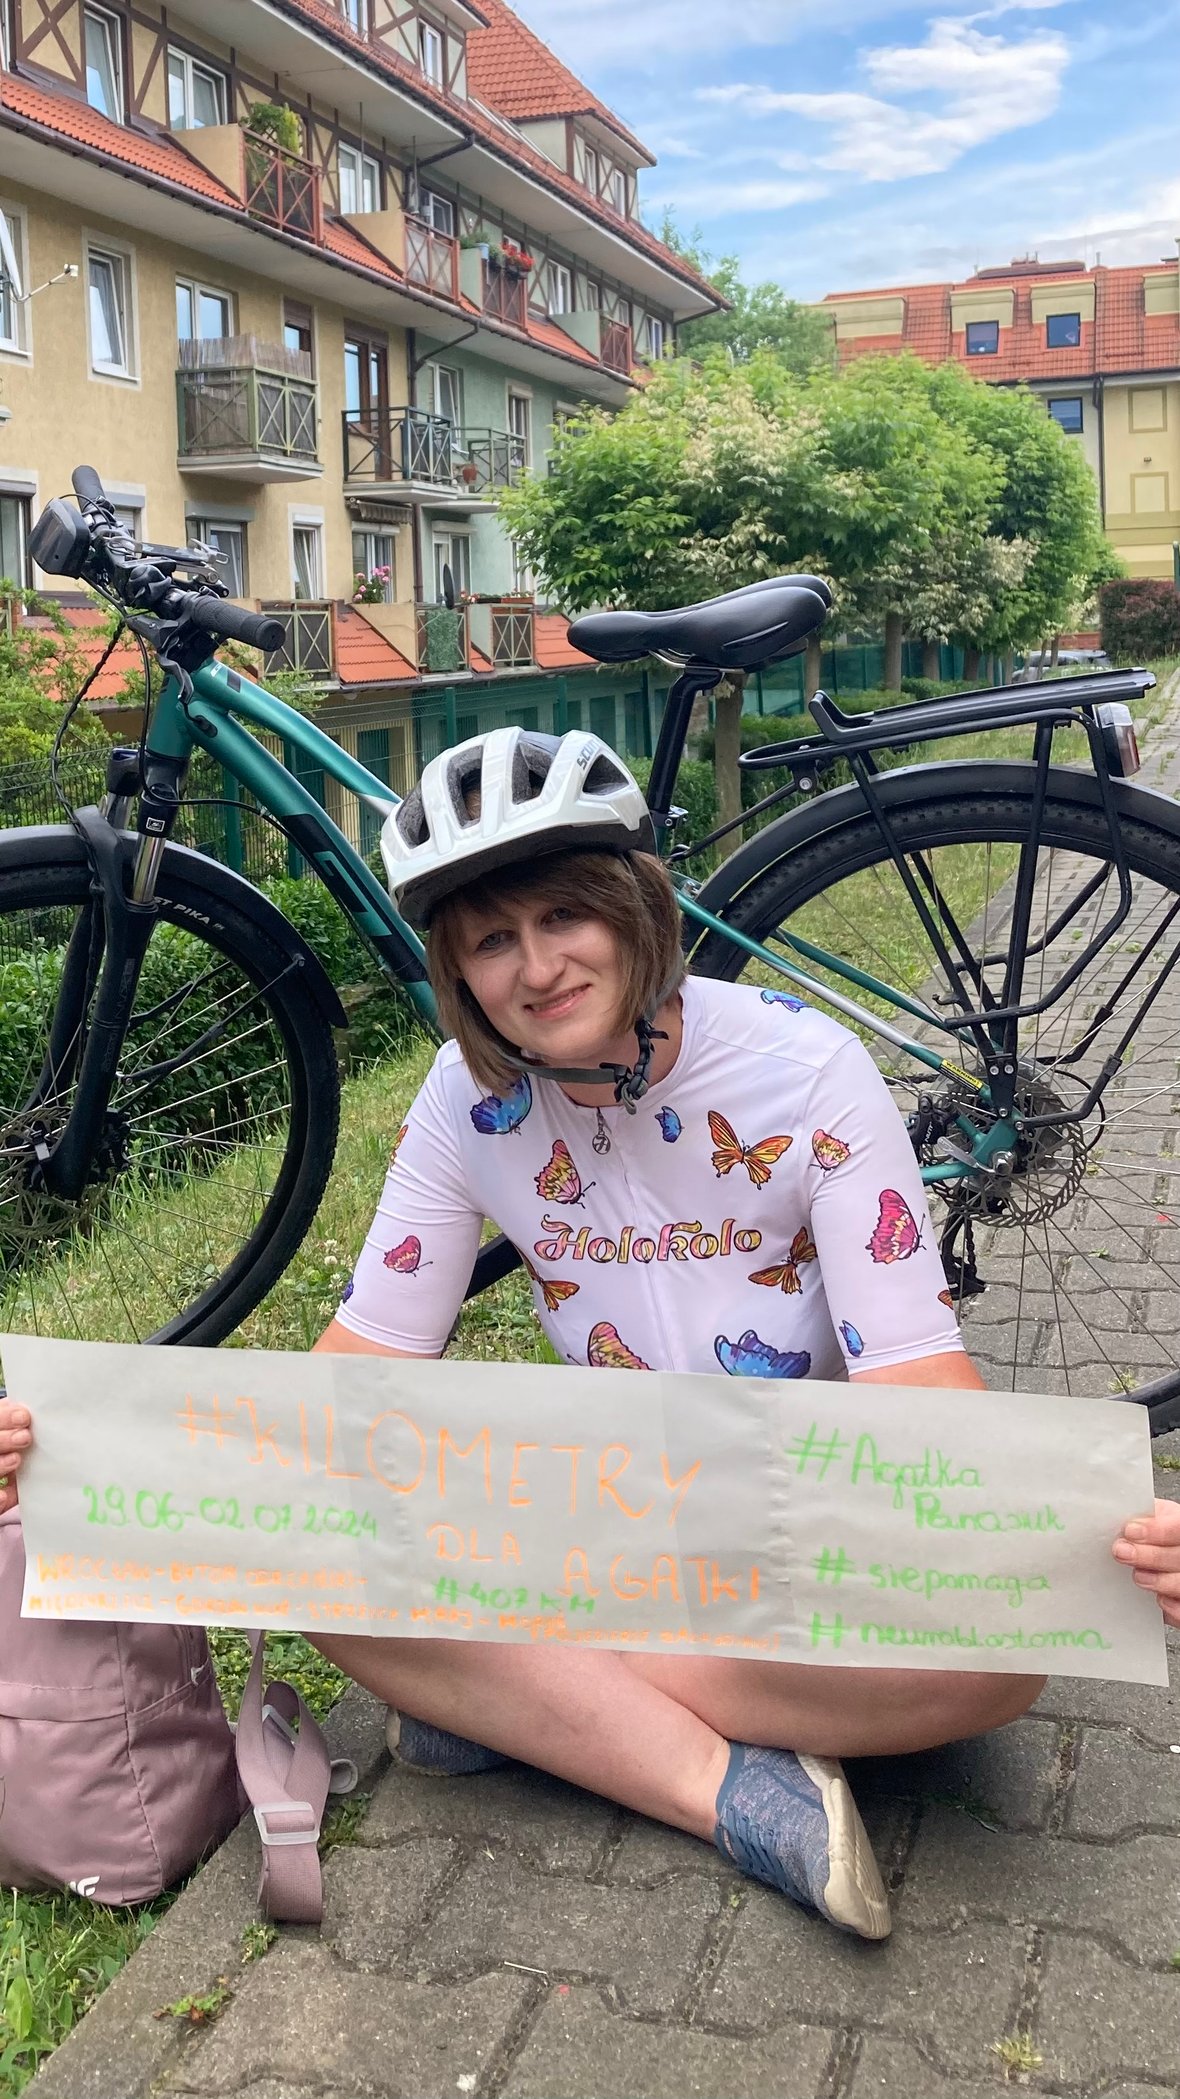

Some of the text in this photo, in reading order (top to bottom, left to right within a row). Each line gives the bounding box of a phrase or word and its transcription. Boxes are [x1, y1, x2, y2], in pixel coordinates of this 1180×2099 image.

[152, 896, 210, 925] ST PIKA
[533, 1214, 762, 1263] Holokolo
[427, 1522, 761, 1606] DLA AGATKI
